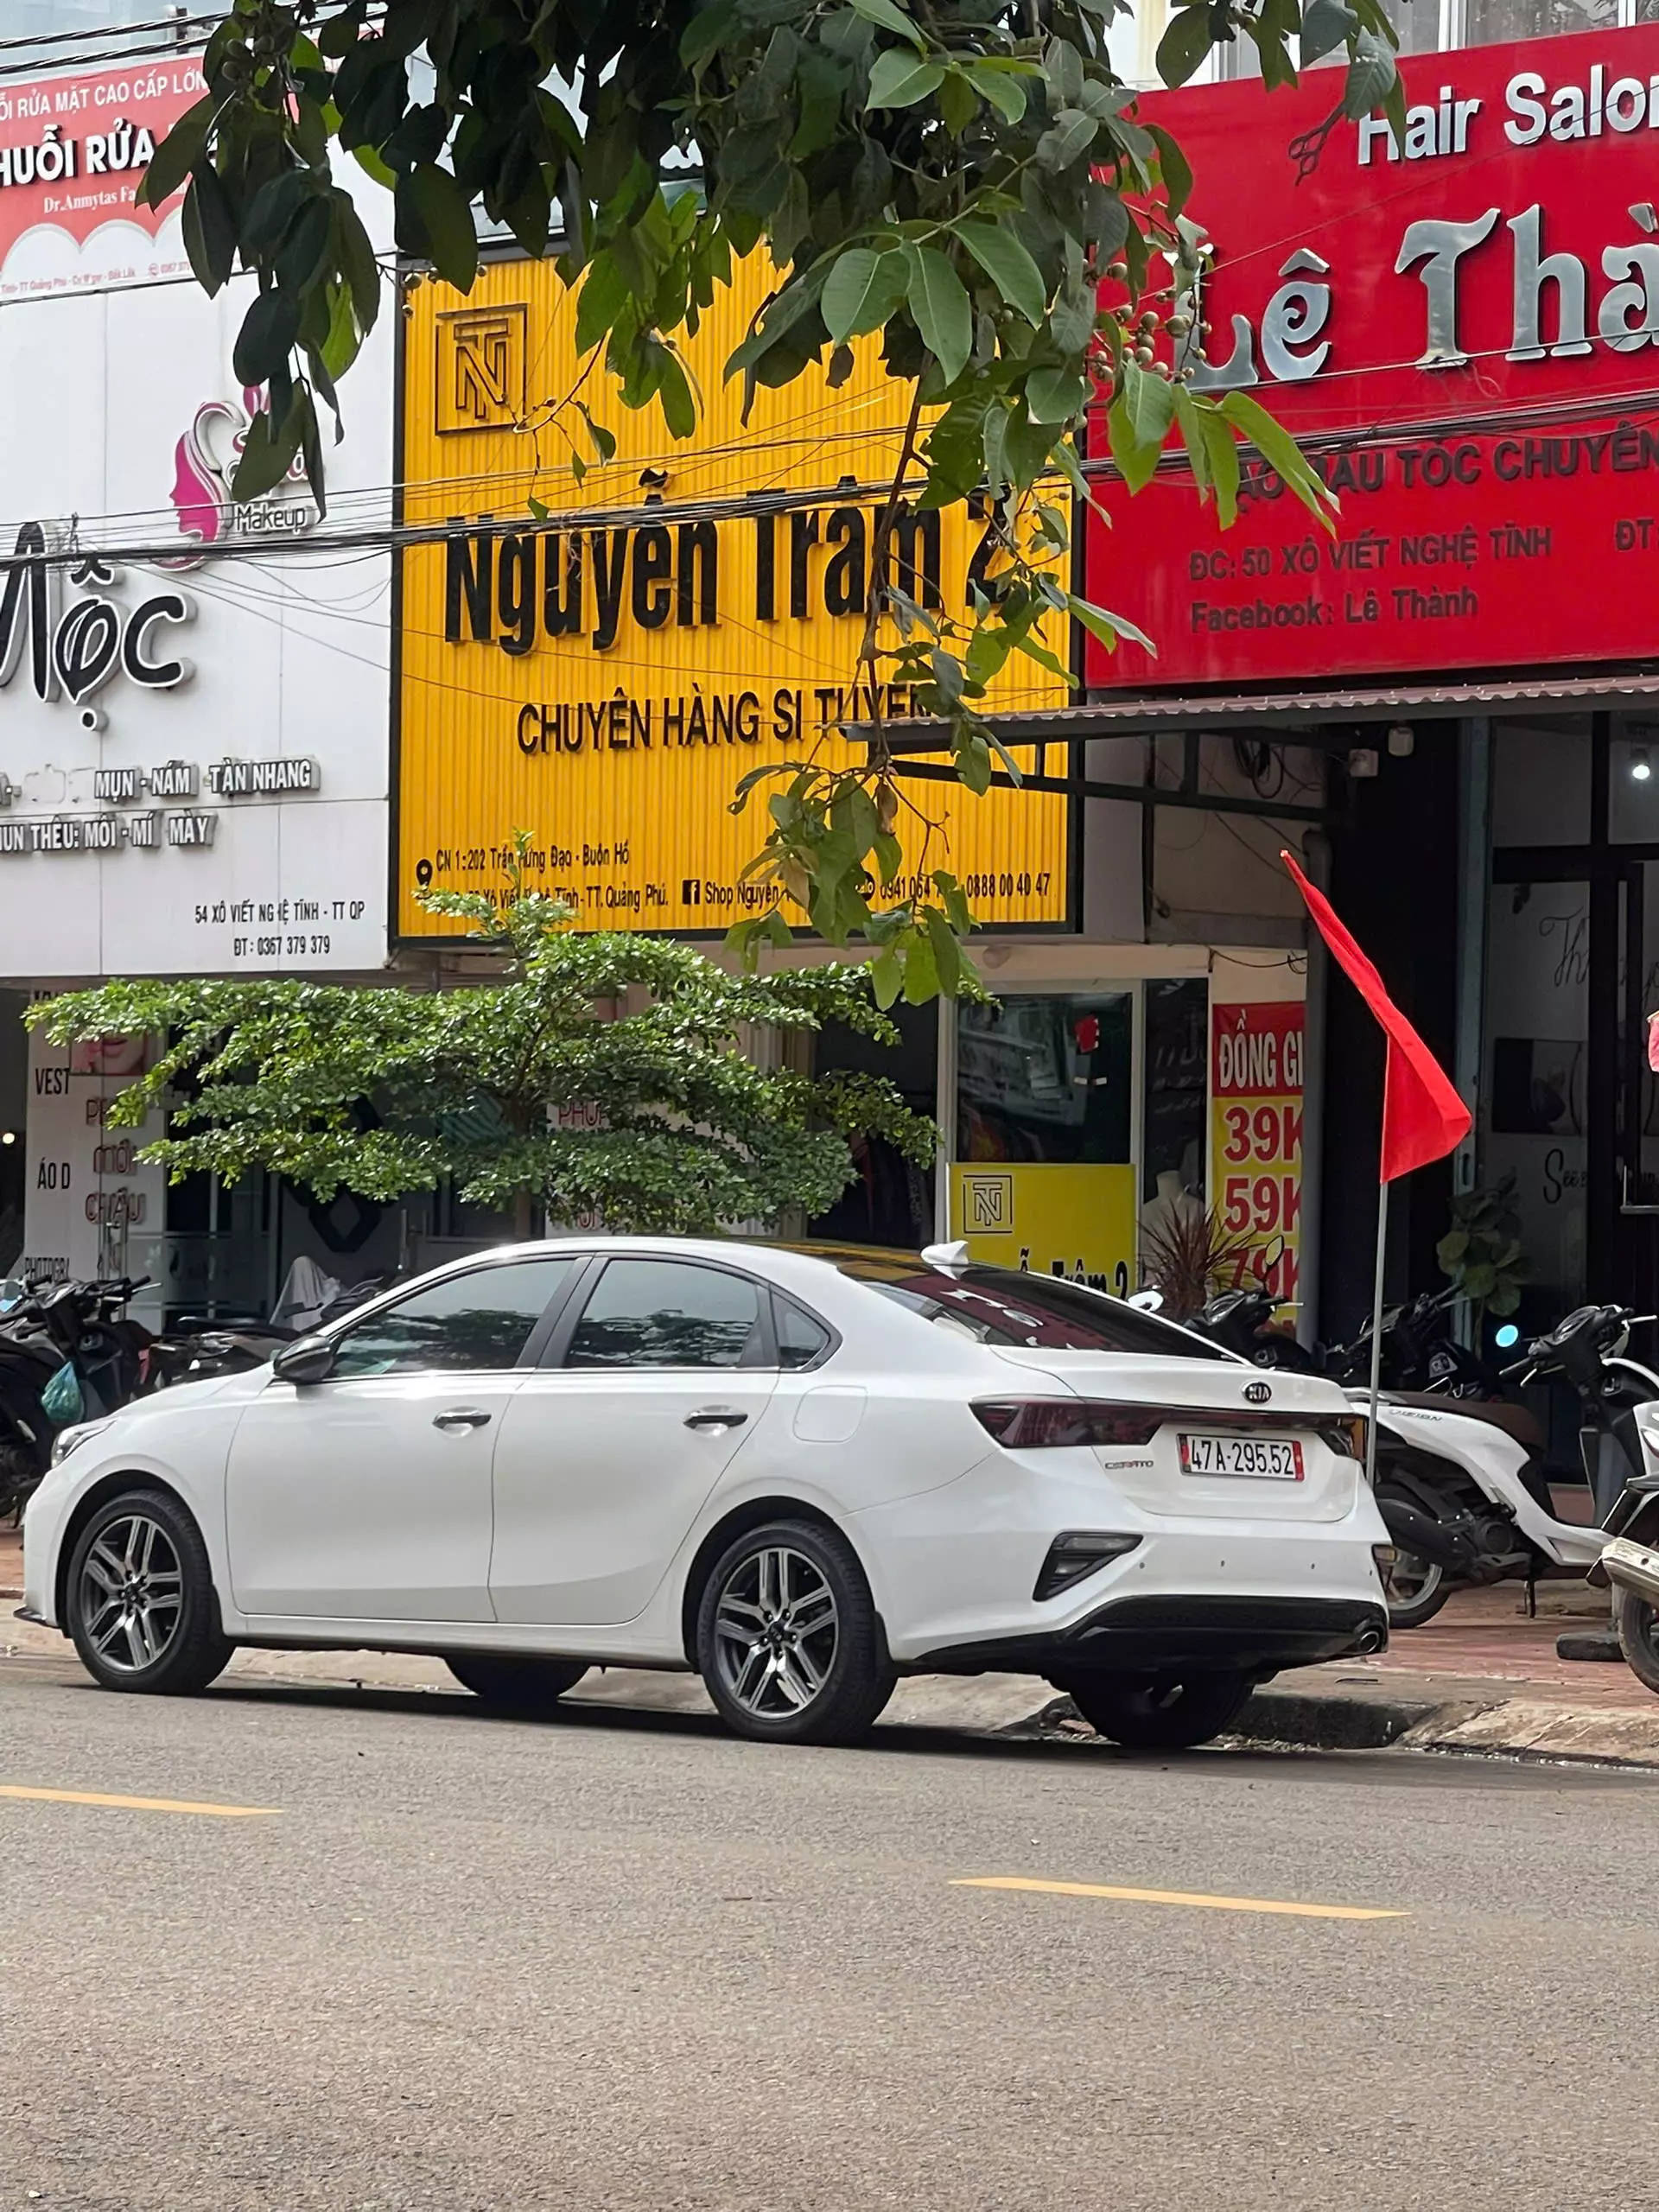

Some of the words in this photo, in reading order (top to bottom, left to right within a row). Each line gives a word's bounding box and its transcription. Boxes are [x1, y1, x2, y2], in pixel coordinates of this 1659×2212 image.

[18, 89, 51, 118] RỬA
[55, 86, 90, 114] MẶT
[94, 82, 130, 106] CAO
[134, 69, 168, 100] CẤP
[86, 117, 156, 175] RỬA
[1358, 86, 1482, 166] Hair
[1163, 233, 1332, 393] Lê
[235, 504, 306, 534] Makeup
[444, 467, 721, 657] Nguyễn
[1189, 551, 1236, 582] ĐC:
[1242, 547, 1271, 578] 50
[1281, 536, 1319, 575] XÔ
[1328, 526, 1390, 572] VIẾT
[1400, 524, 1478, 571] NGHỆ
[1490, 520, 1552, 560] TĨNH
[1190, 595, 1333, 634] Facebook:
[1345, 590, 1379, 626] Lê
[1390, 584, 1479, 621] Thành
[518, 685, 652, 754] CHUYÊN
[663, 682, 761, 747] HÀNG
[95, 770, 134, 804] MỤN
[210, 757, 247, 794] TÀN
[252, 759, 311, 791] NHANG
[30, 814, 79, 850] THÊU:
[85, 812, 118, 848] MÔI
[132, 810, 156, 847] MÍ
[169, 809, 210, 844] MÀY
[435, 849, 451, 872] CN
[455, 848, 486, 871] 1:202
[550, 845, 572, 873] Đạo
[605, 881, 641, 913] Quảng
[705, 881, 734, 911] Shop
[966, 874, 995, 898] 0888
[999, 873, 1014, 896] 00
[1016, 873, 1032, 896] 40
[1035, 873, 1052, 896] 47
[195, 906, 208, 924] 54
[212, 900, 226, 923] XÔ
[231, 899, 255, 923] VIẾT
[333, 901, 346, 920] TT
[350, 901, 365, 920] QP
[287, 936, 306, 954] 379
[310, 935, 330, 954] 379
[1218, 1008, 1278, 1089] ĐỒNG
[35, 1068, 70, 1096] VEST
[1224, 1105, 1303, 1162] 39K
[37, 1156, 57, 1190] ÁO
[1224, 1175, 1302, 1234] 59K
[1246, 1384, 1271, 1402] KIA
[1189, 1438, 1294, 1476] 47A-295.52
